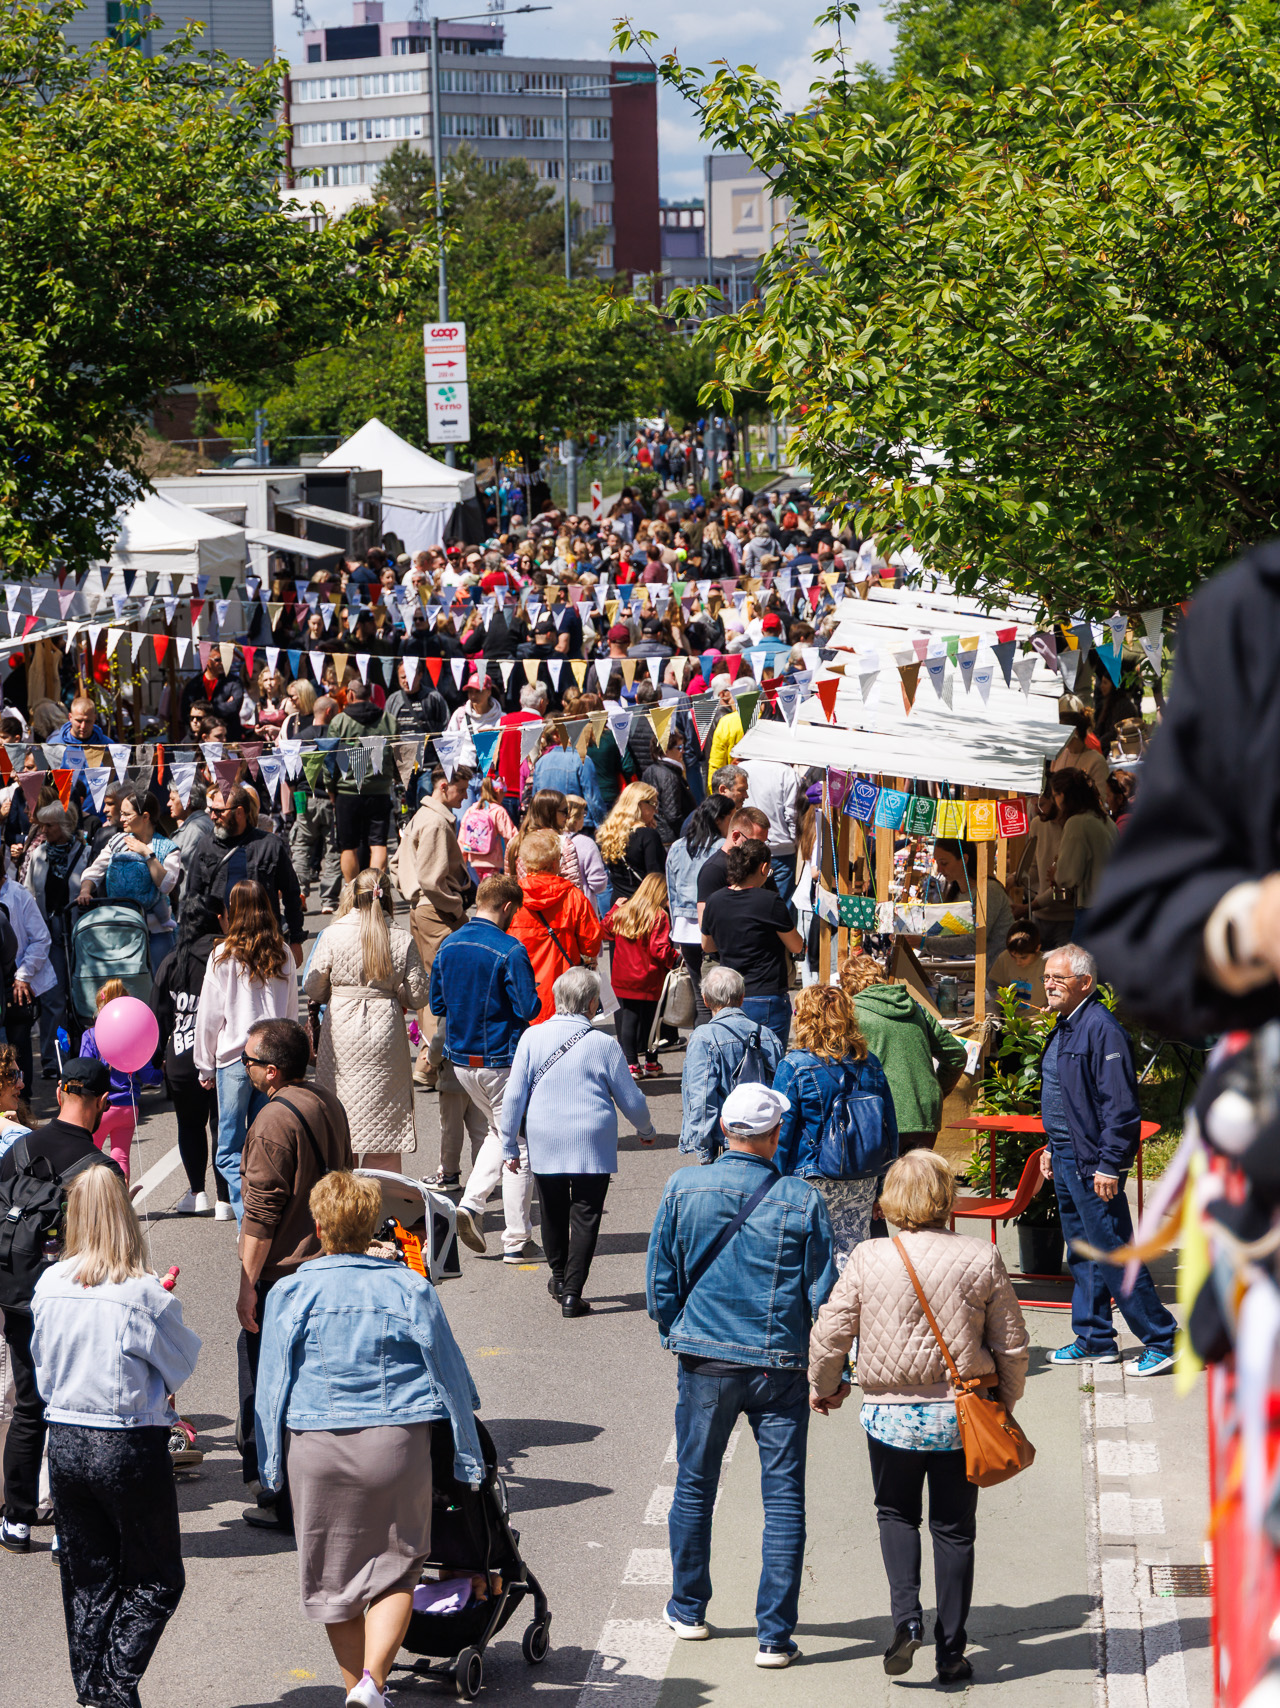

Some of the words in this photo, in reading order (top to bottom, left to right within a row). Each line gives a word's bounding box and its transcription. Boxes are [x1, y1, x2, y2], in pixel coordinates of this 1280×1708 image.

[431, 328, 458, 340] coop
[434, 403, 463, 411] Terno
[174, 1012, 198, 1032] TO
[173, 1029, 195, 1055] BE
